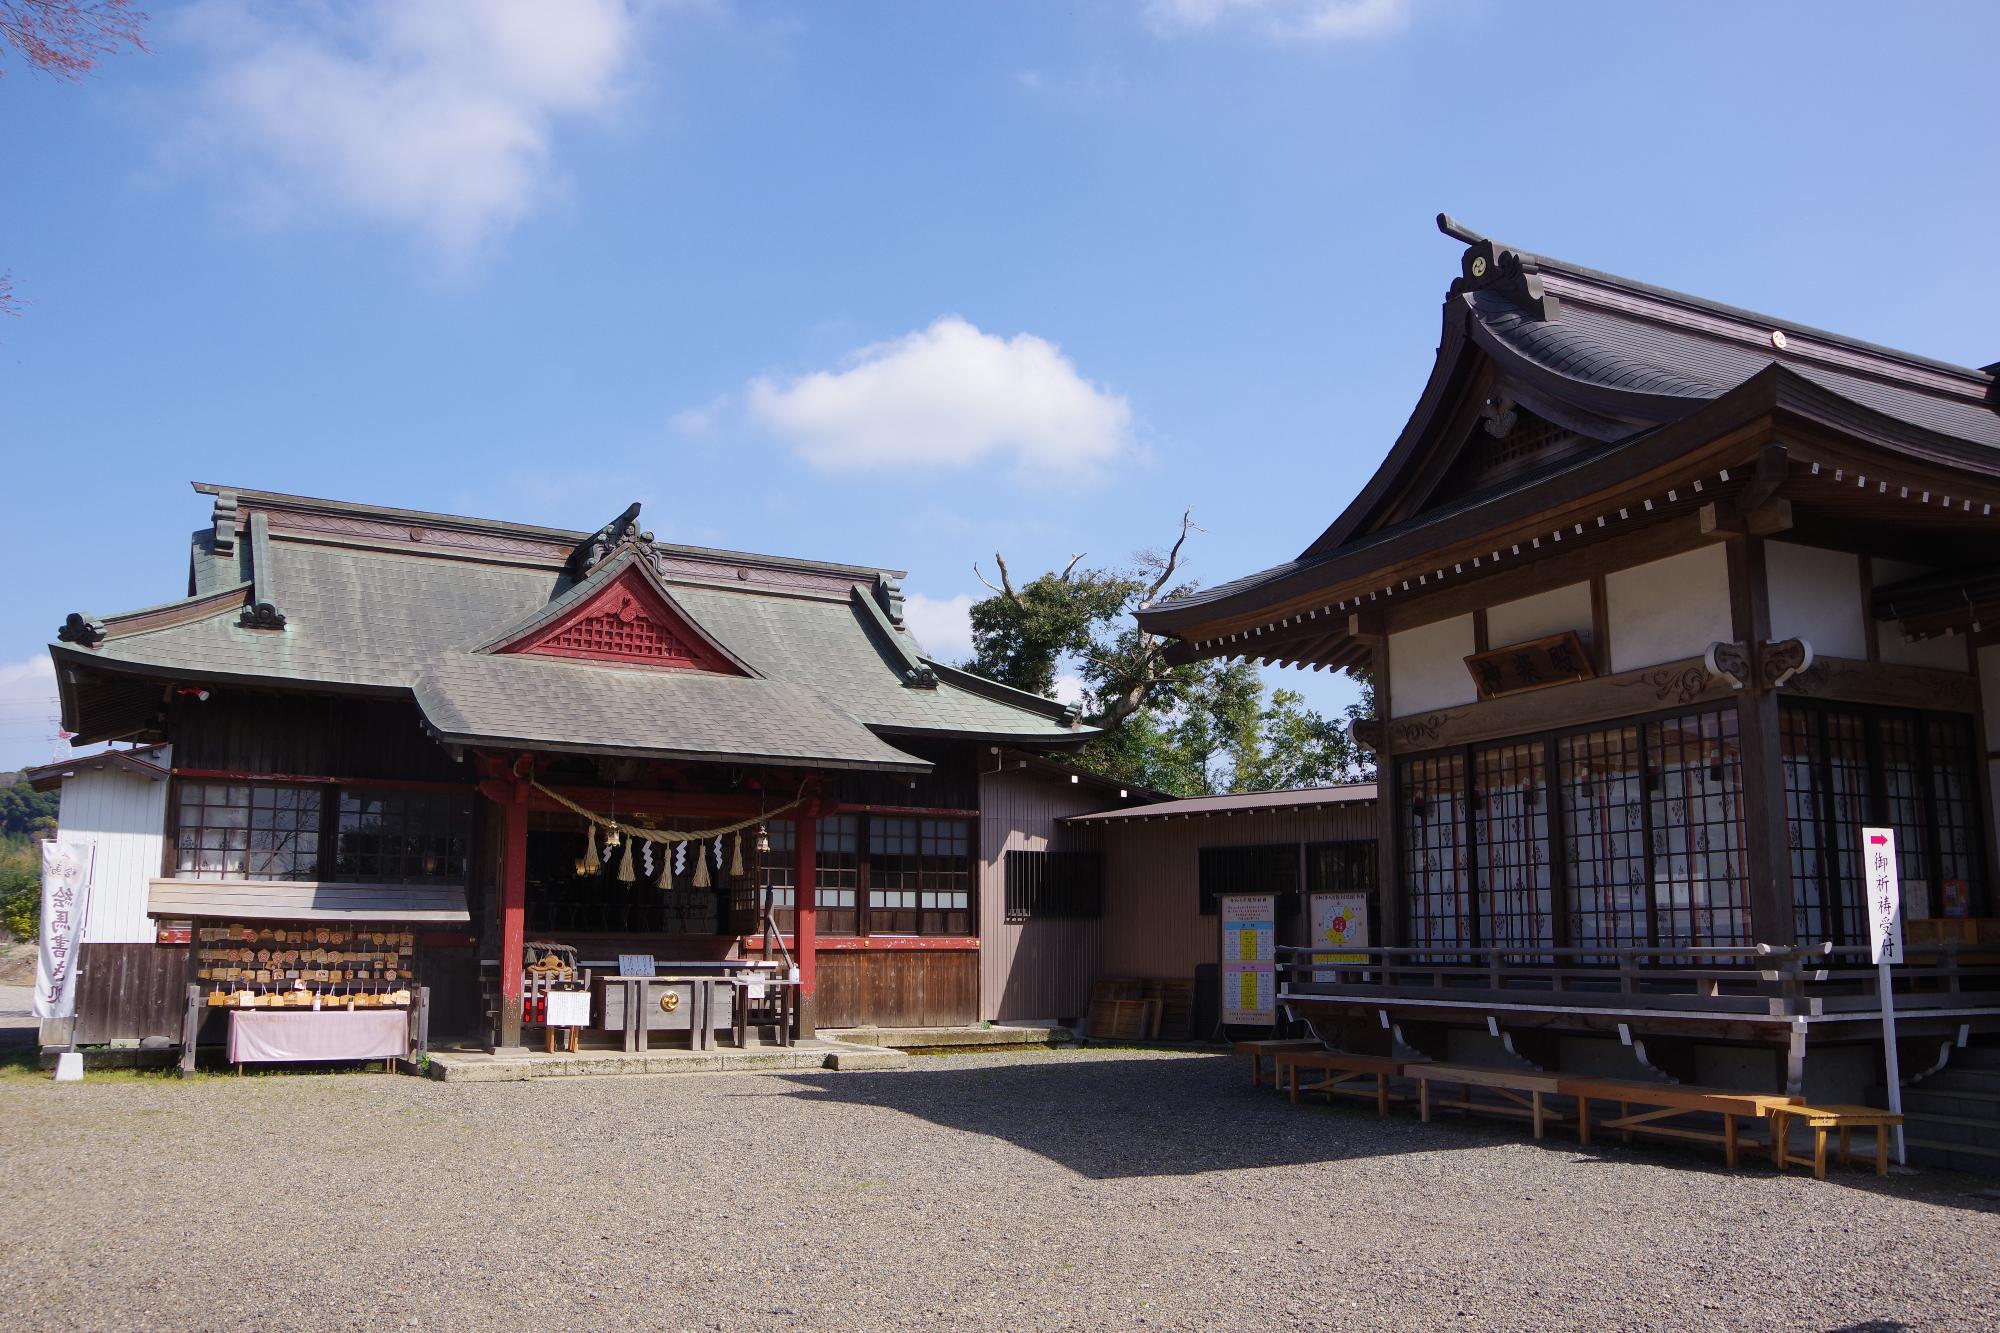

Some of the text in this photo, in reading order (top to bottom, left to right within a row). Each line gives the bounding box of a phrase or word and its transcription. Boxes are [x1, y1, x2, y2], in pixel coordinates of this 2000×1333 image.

[1874, 852, 1895, 958] 御祈祷受付
